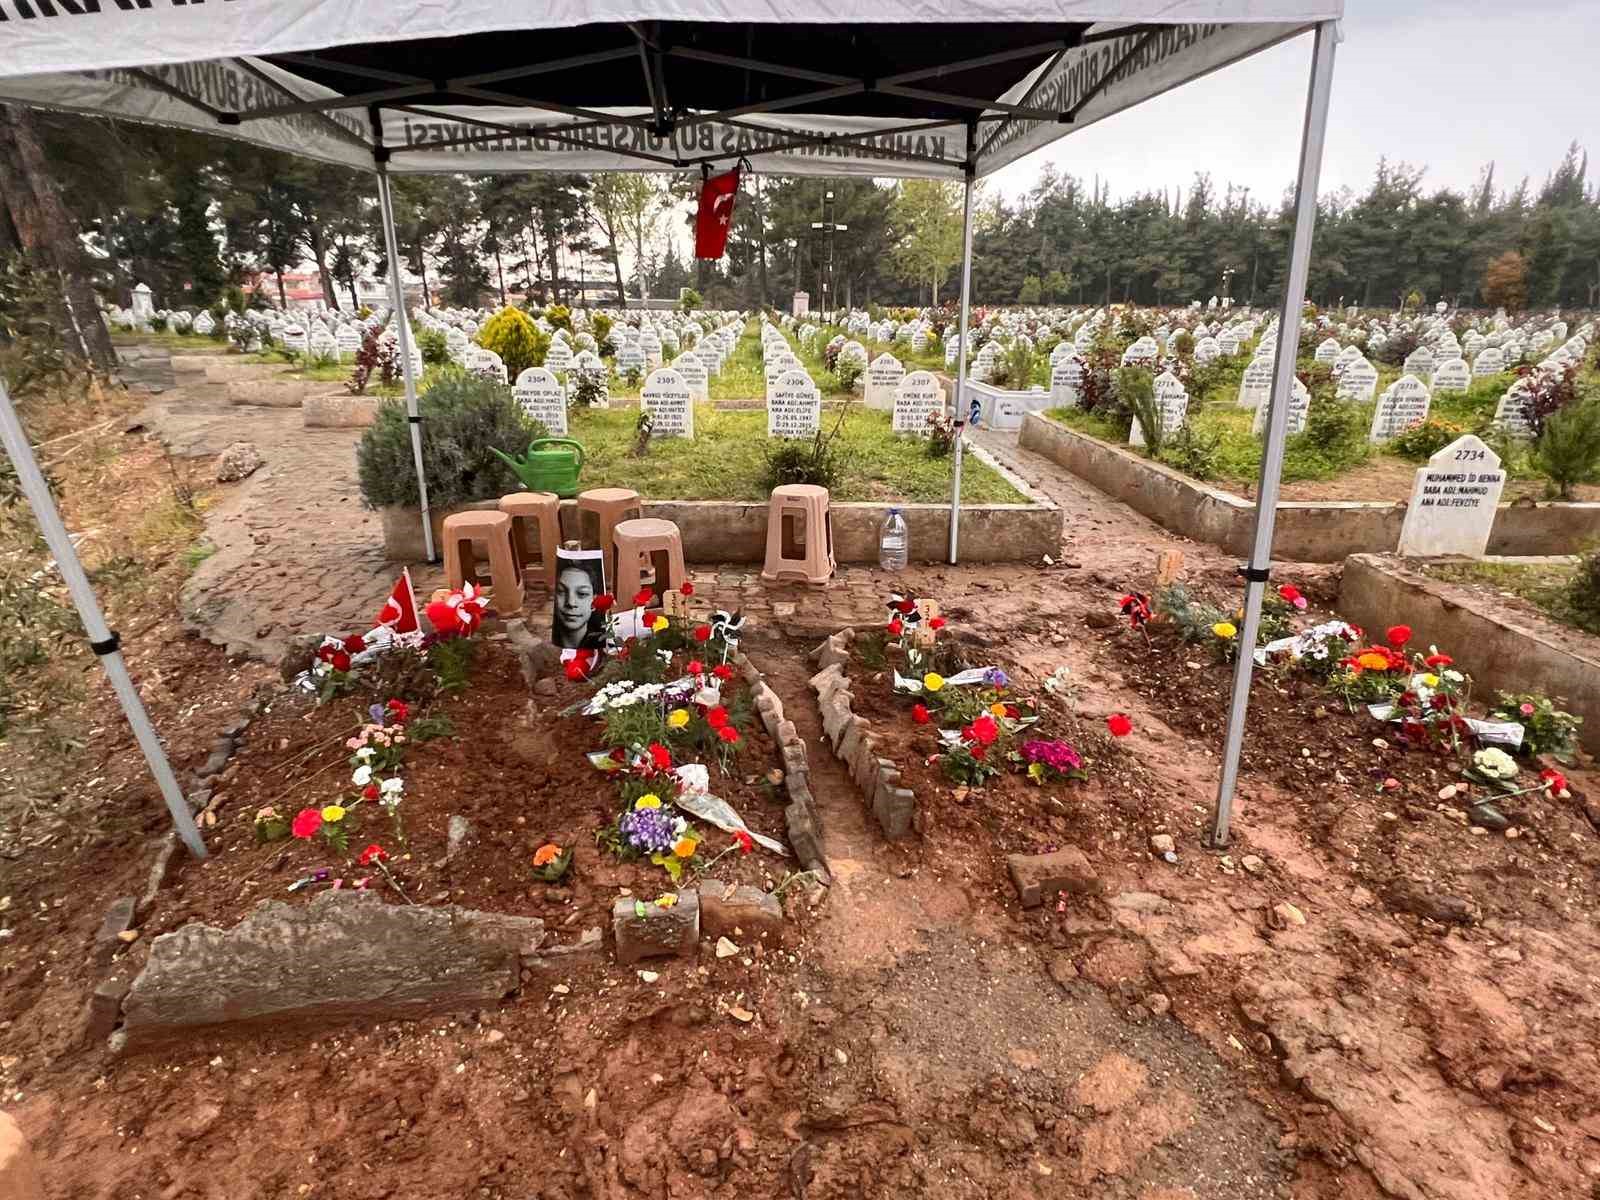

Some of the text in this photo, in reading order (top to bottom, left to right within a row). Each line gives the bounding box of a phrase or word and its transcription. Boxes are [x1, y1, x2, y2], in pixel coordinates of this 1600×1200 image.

[656, 376, 676, 384] 2305
[786, 378, 805, 386] 2306
[1455, 450, 1485, 461] 2734
[1426, 473, 1467, 483] MUHAMMED
[1423, 486, 1441, 495] BABA
[1420, 498, 1435, 507] ANA
